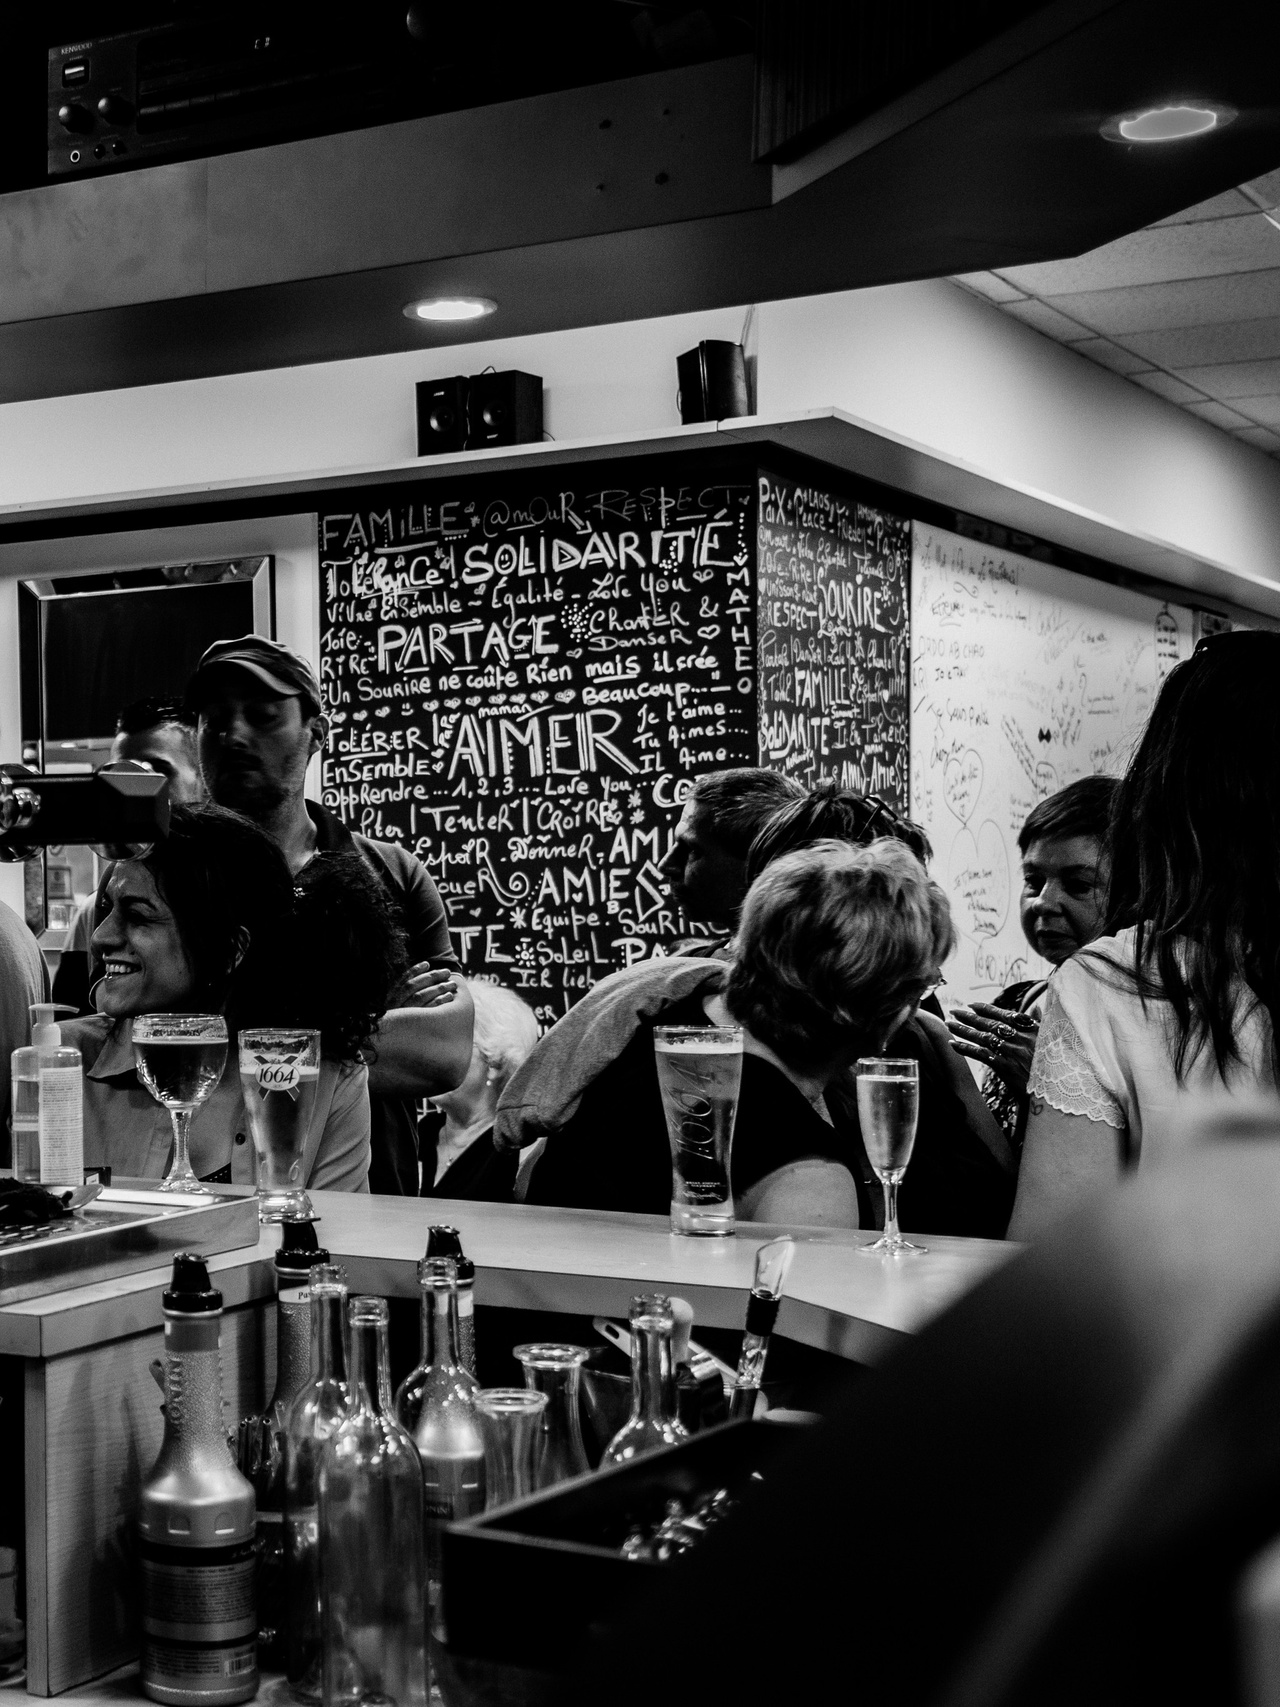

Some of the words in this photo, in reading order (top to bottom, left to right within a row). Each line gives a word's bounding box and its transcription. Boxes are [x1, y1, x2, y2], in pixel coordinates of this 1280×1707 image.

[767, 601, 818, 631] RESPECT
[817, 567, 883, 631] SOURIRE
[377, 615, 559, 674] PARTAGE
[699, 596, 719, 618] &
[439, 676, 461, 690] ne
[466, 665, 519, 690] coûte
[586, 655, 641, 678] mais
[478, 702, 532, 719] maman
[637, 704, 660, 733] Je
[447, 708, 639, 781] AIMER
[633, 732, 661, 750] Tu
[545, 776, 589, 795] Love
[258, 1065, 297, 1084] 1664
